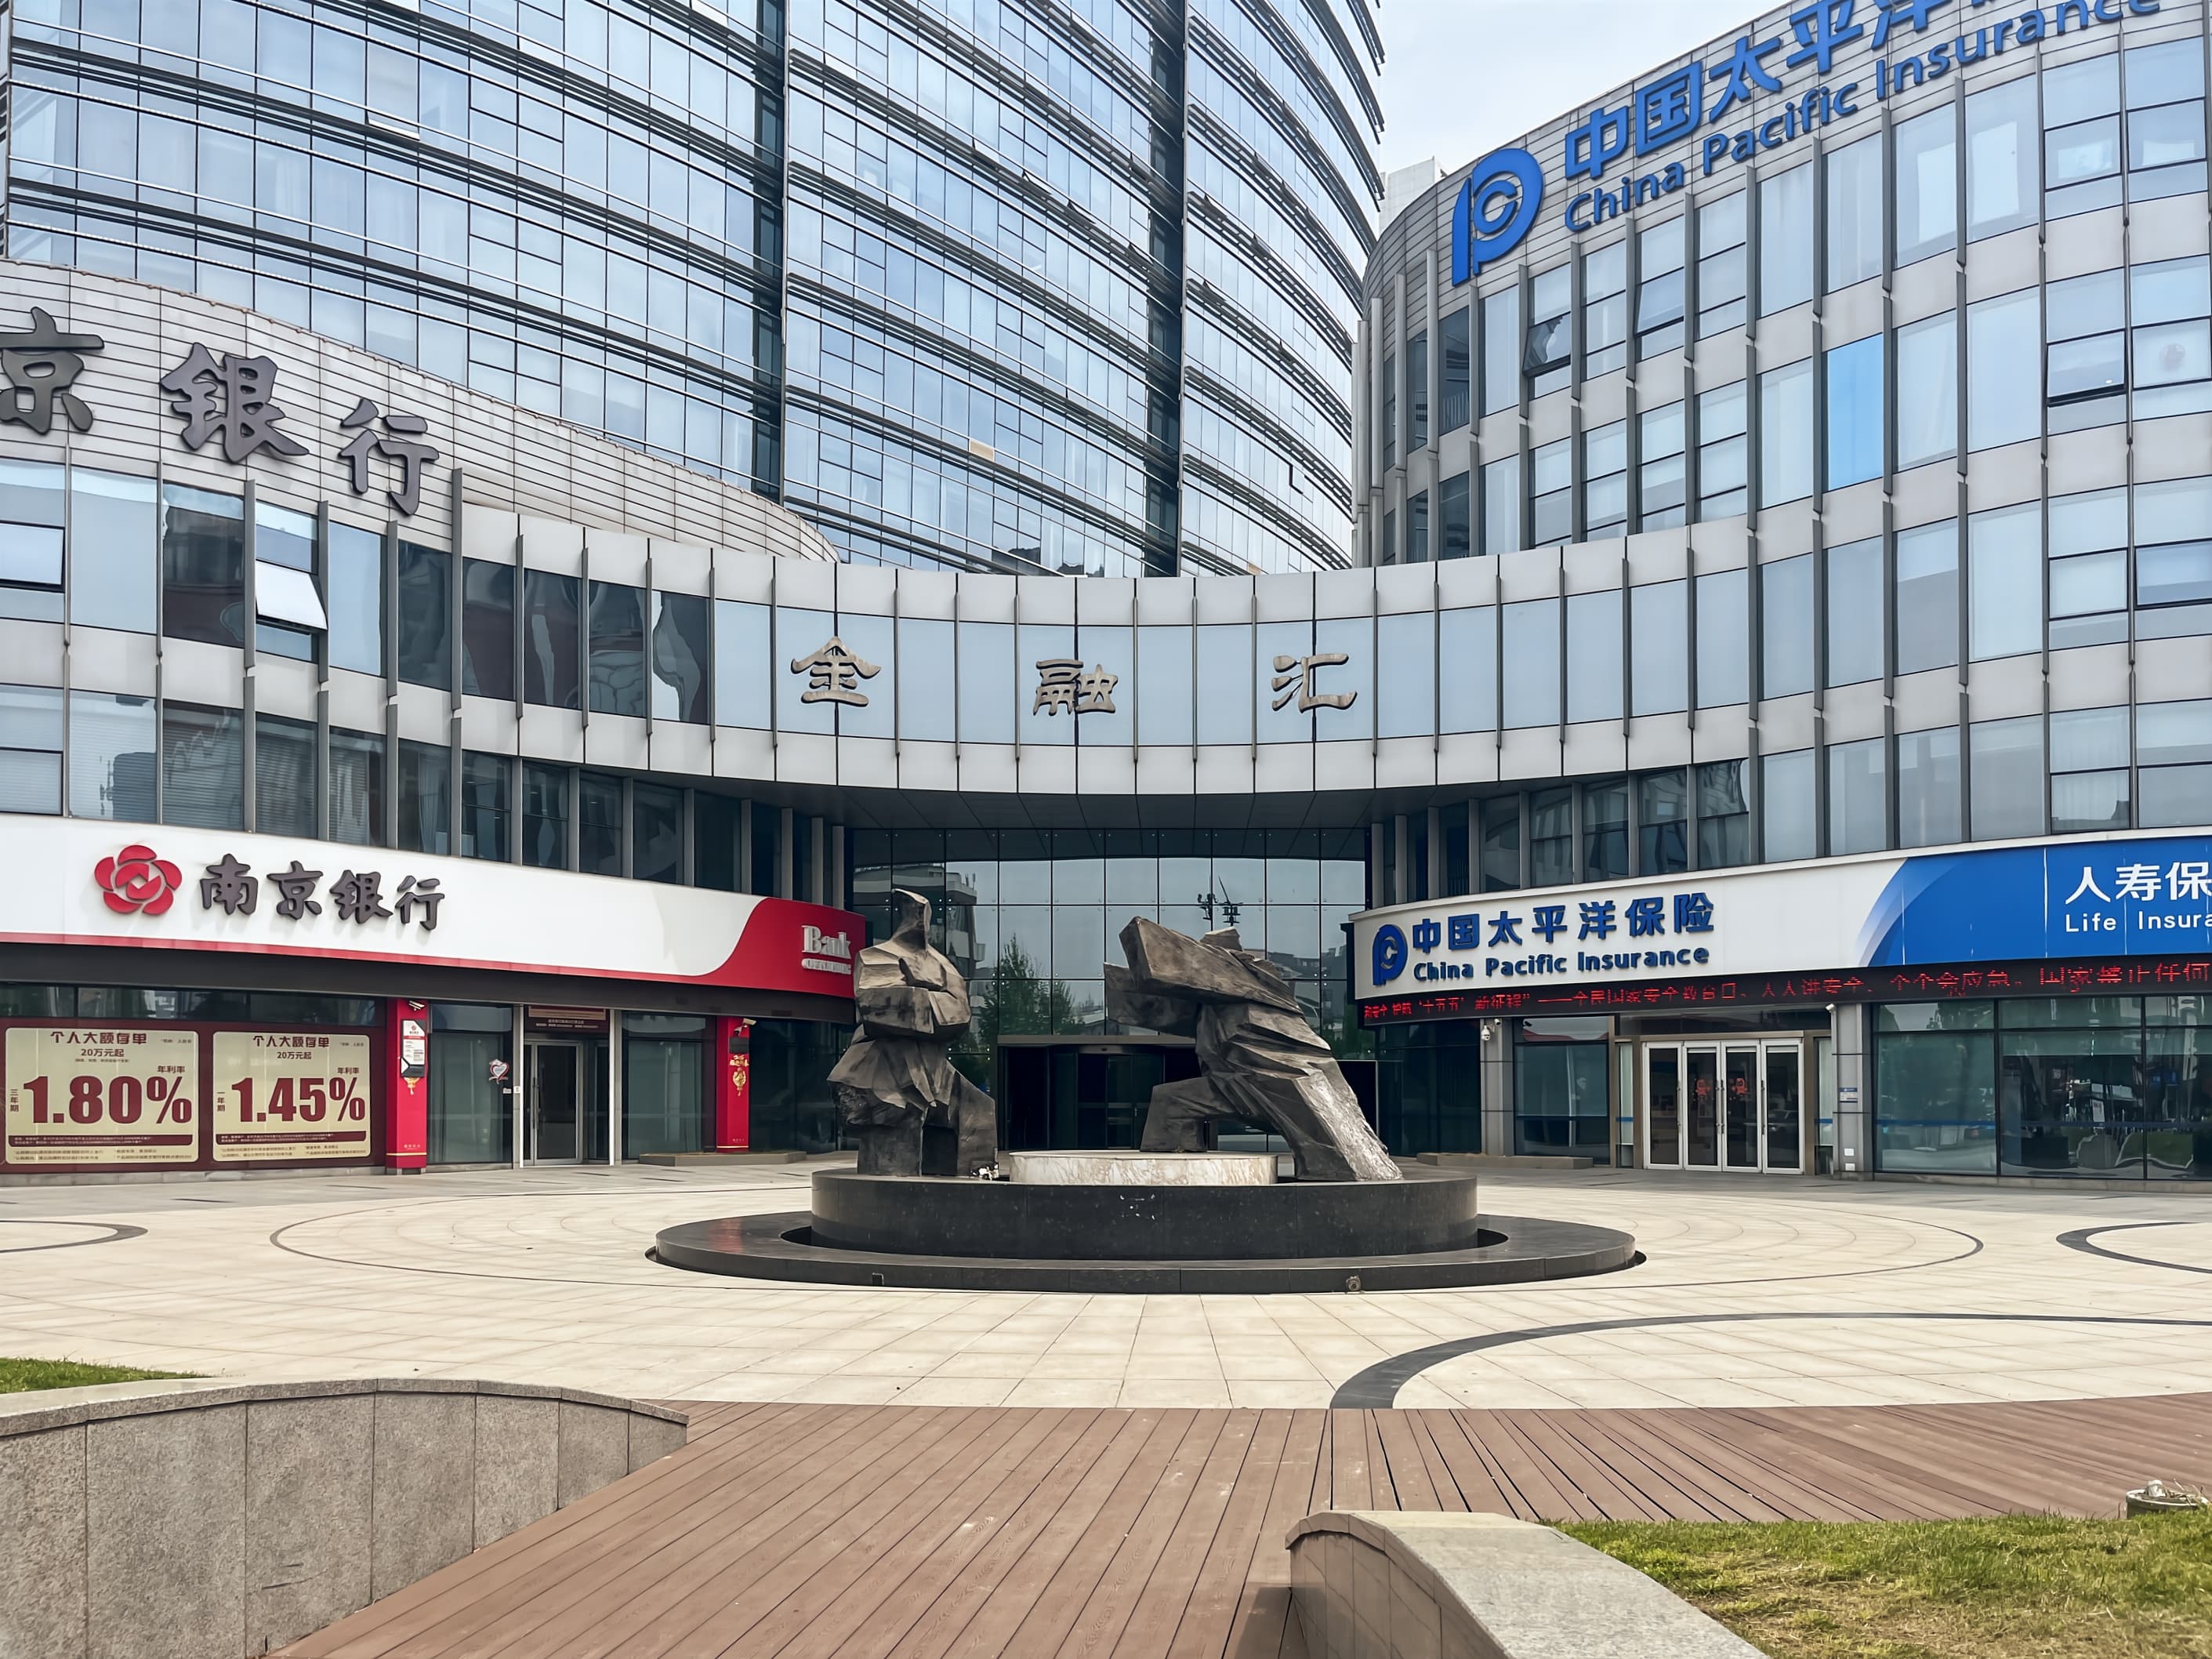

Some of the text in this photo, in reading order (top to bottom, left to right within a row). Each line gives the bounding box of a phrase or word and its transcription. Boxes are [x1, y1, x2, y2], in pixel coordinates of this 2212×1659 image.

[1565, 161, 1684, 233] China
[1703, 81, 1858, 176] Pacific
[790, 636, 1358, 717] 金融汇
[2065, 862, 2212, 905] 人寿保
[801, 925, 851, 959] Bank
[1412, 891, 1714, 953] 中国太平洋保险
[2065, 913, 2117, 932] Life
[1413, 945, 1710, 982] China Pacific Insurance
[81, 1048, 125, 1057] 20万元起
[9, 1089, 19, 1112] 三年期
[24, 1076, 192, 1124] 1.80%
[231, 1077, 365, 1122] 1.45%
